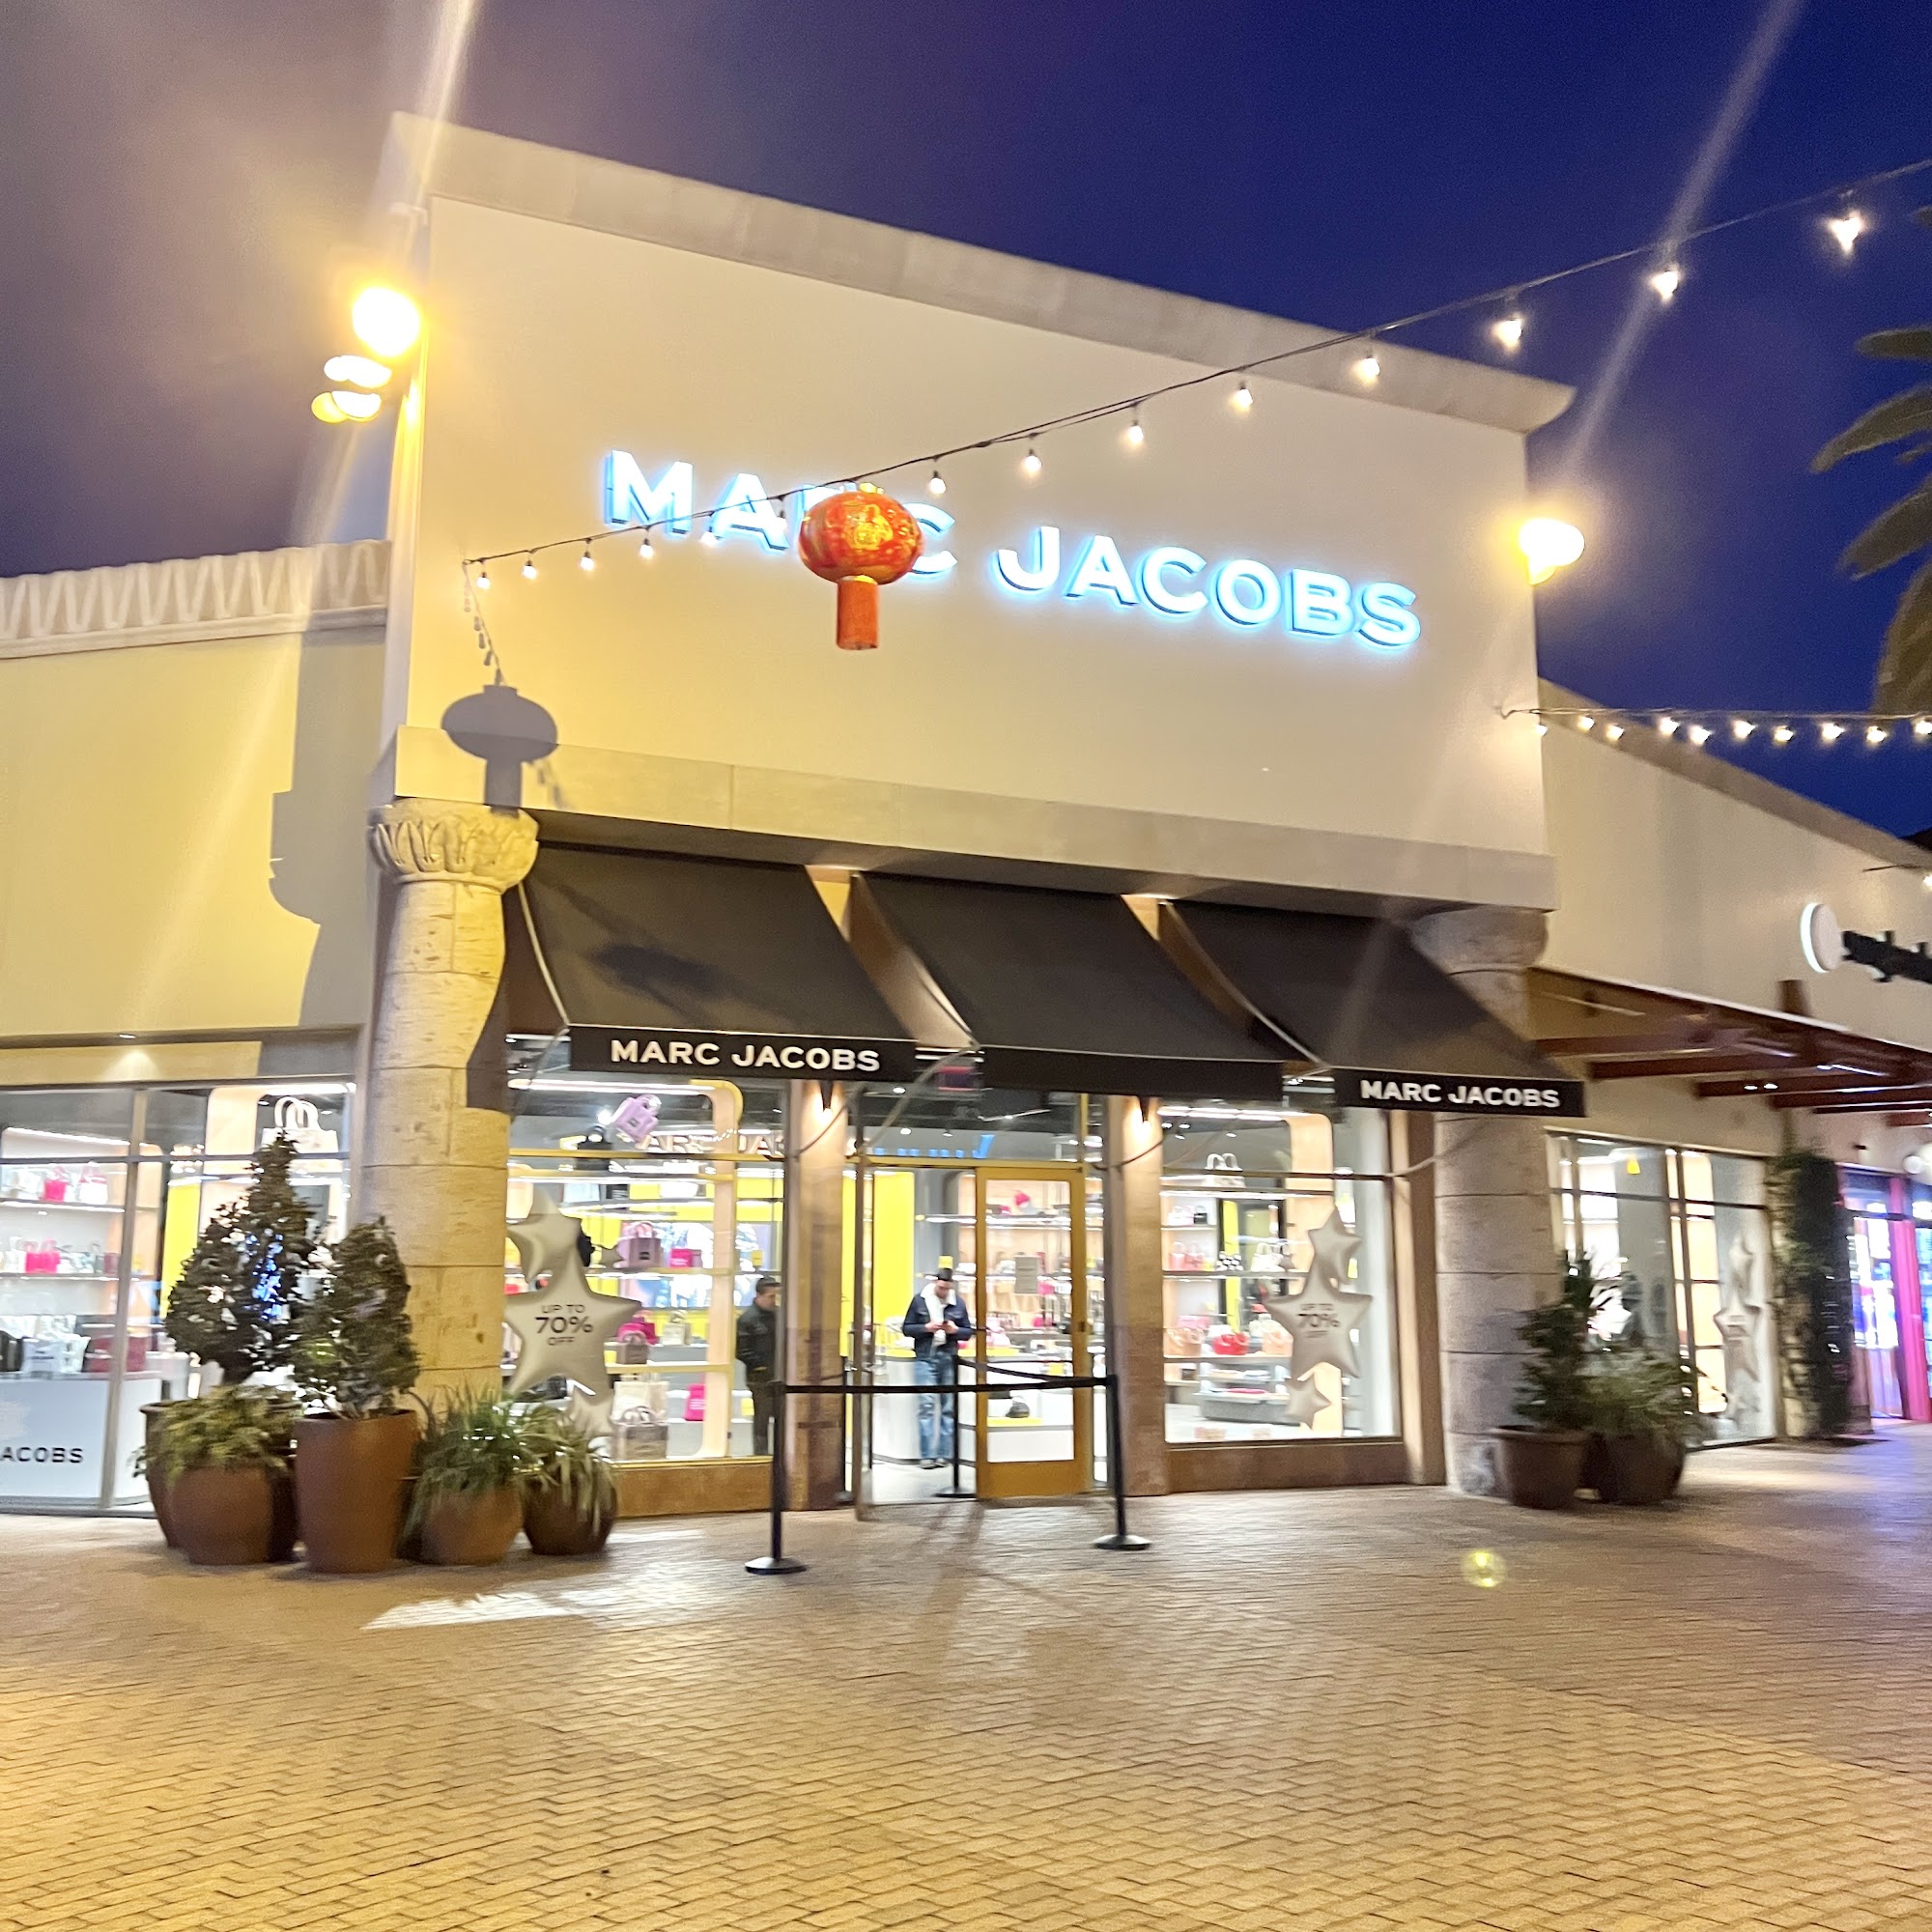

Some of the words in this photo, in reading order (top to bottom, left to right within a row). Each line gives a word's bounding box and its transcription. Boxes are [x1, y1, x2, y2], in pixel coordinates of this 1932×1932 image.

[605, 450, 957, 575] MAC
[993, 526, 1422, 646] JACOBS
[611, 1039, 720, 1065] MARC
[731, 1044, 880, 1071] JACOBS
[1360, 1080, 1441, 1102] MARC
[1447, 1086, 1561, 1108] JACOBS
[542, 1304, 562, 1314] UP
[566, 1304, 585, 1314] TO
[534, 1316, 593, 1333] 70%
[548, 1336, 575, 1346] OFF
